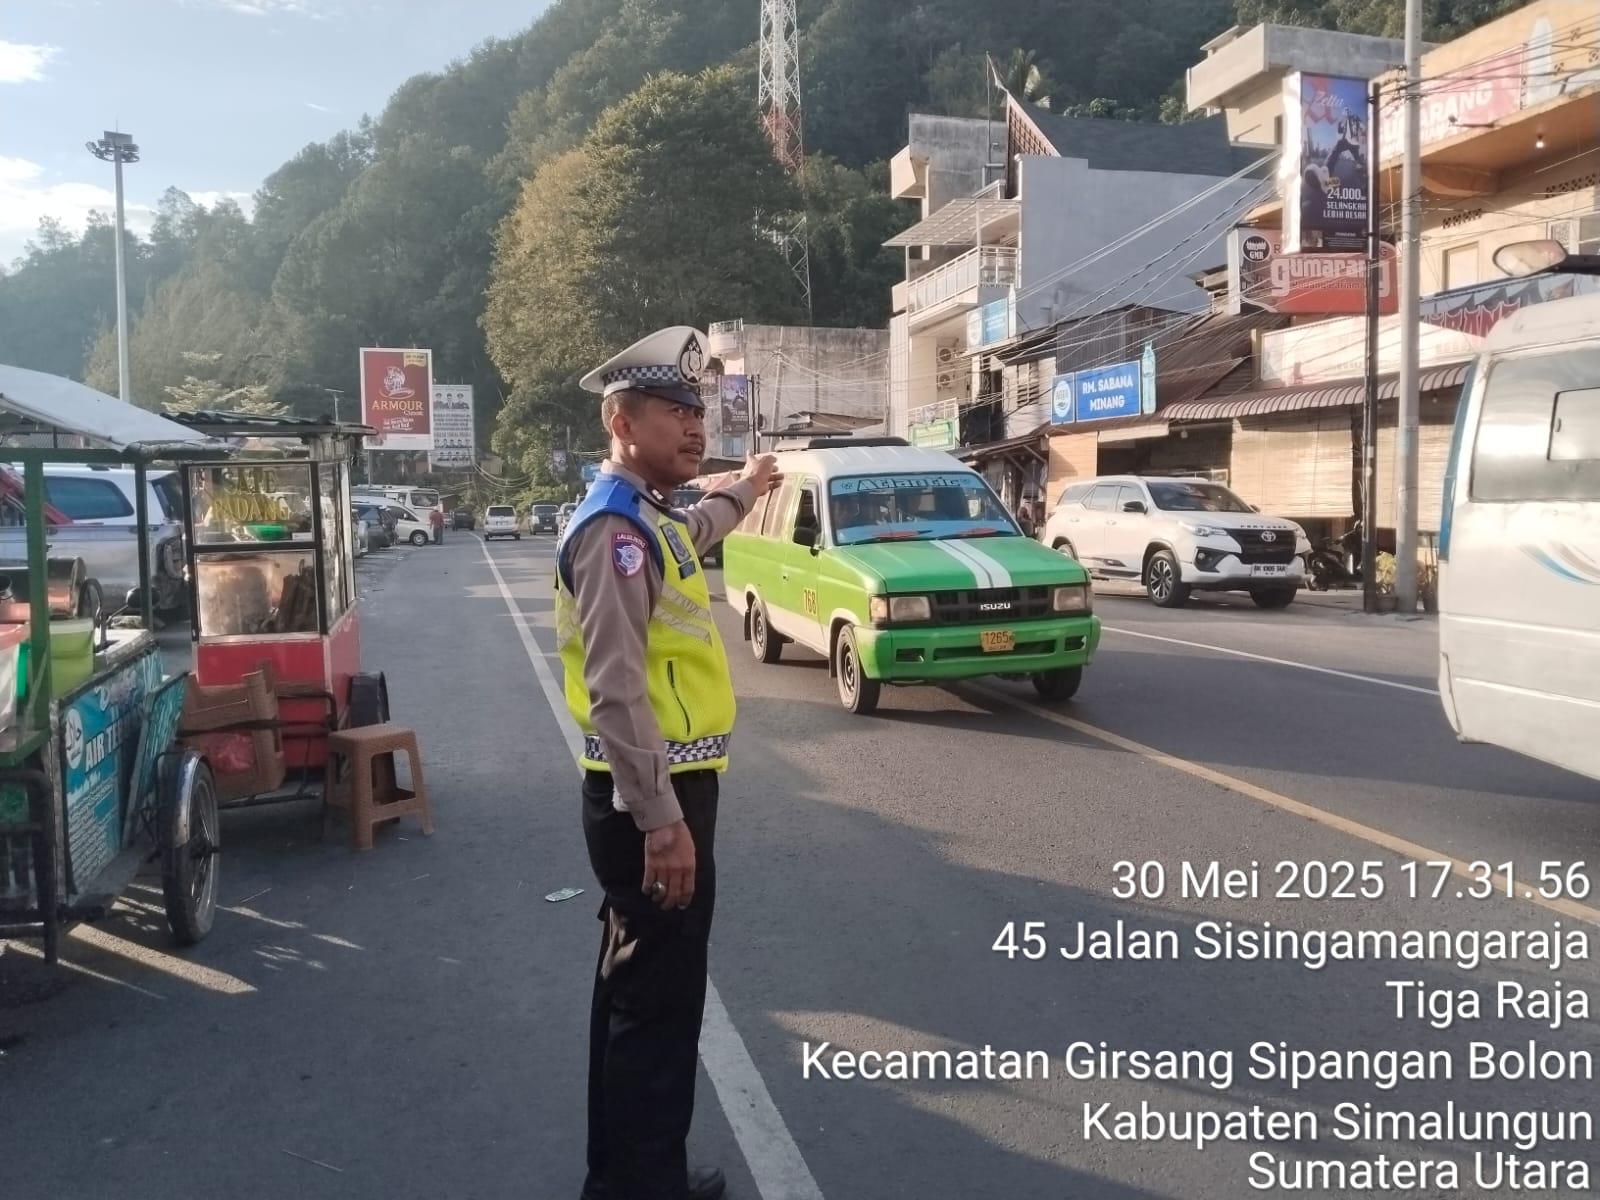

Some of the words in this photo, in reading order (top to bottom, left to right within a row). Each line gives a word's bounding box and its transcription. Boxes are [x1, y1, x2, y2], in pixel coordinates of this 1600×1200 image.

[1098, 373, 1134, 393] SABANA
[371, 399, 425, 412] ARMOUR
[1089, 394, 1125, 412] MINANG
[980, 602, 1011, 611] ISUZU
[85, 733, 105, 773] AIR
